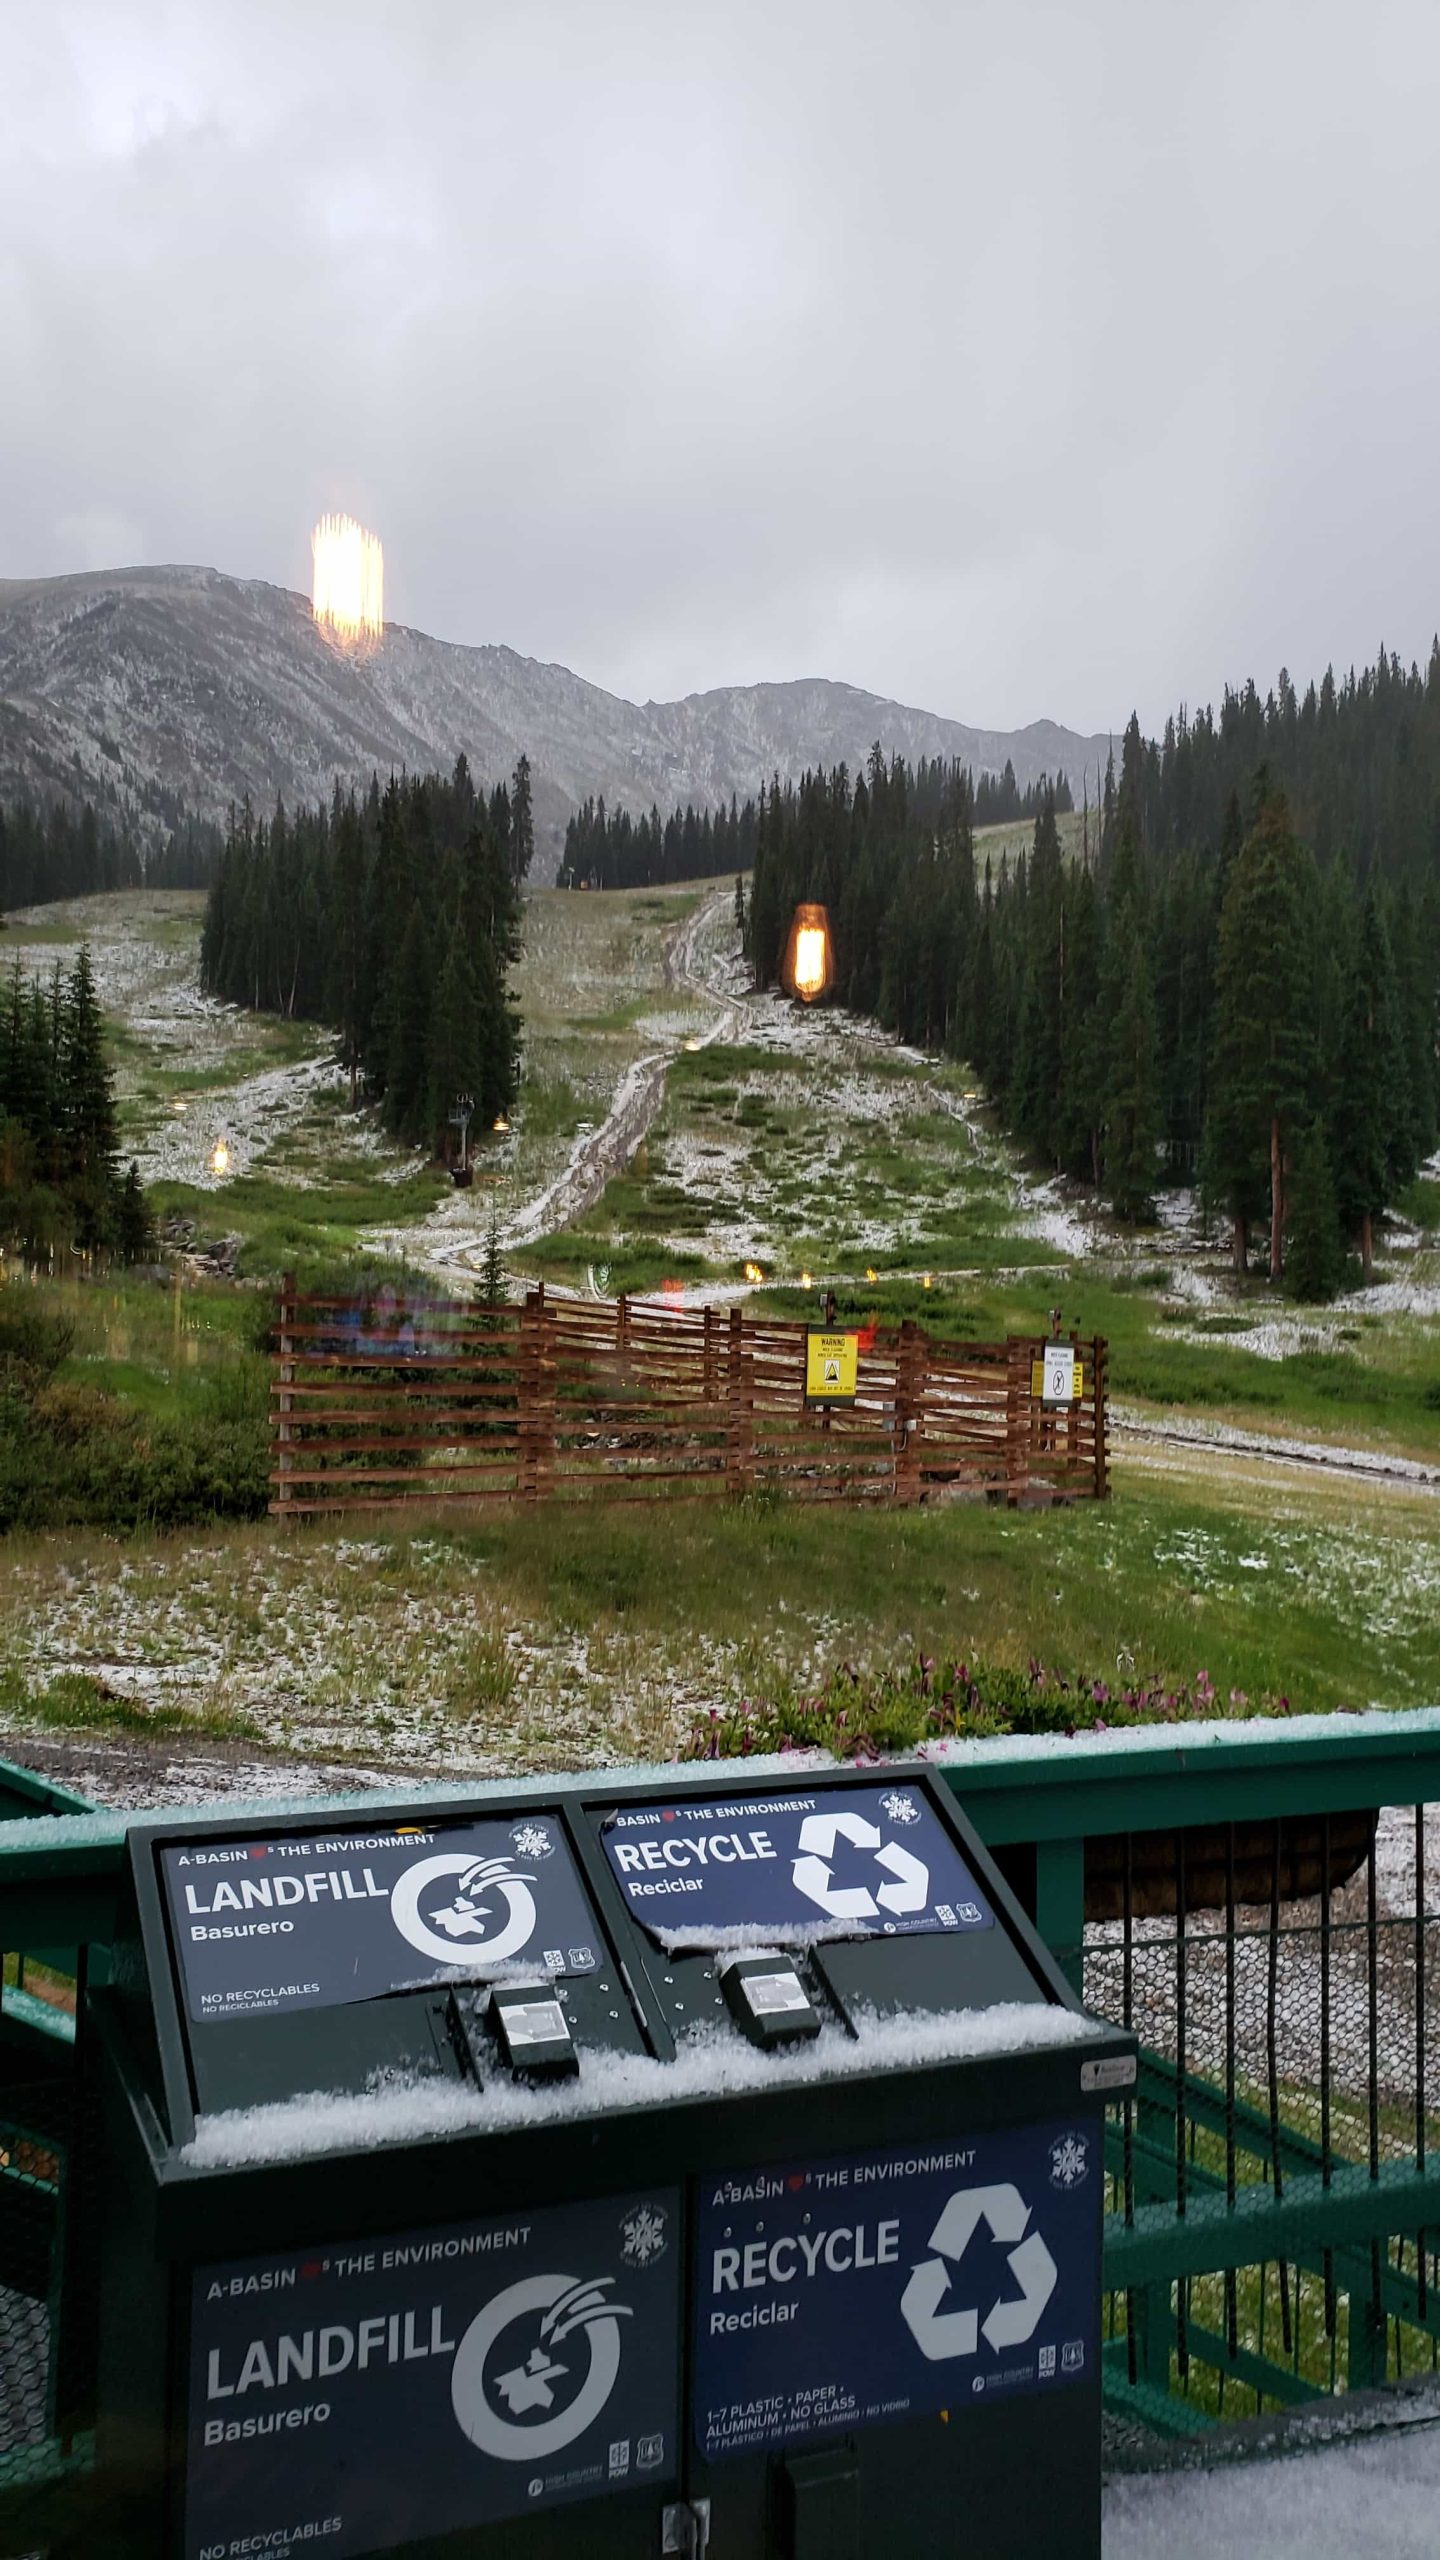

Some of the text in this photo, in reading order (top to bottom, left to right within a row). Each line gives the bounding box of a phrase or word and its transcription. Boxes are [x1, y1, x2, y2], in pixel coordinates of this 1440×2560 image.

[821, 1338, 845, 1346] WARNING
[616, 1813, 661, 1827] BASIN
[684, 1808, 713, 1820] THE
[715, 1799, 816, 1818] ENVIRONMENT
[178, 1850, 248, 1866] A-BASIN
[278, 1843, 310, 1857] THE
[315, 1834, 435, 1853] ENVIRONMENT
[614, 1831, 777, 1872] RECYCLE
[185, 1868, 389, 1914] LANDFILL
[627, 1876, 704, 1897] Reciclar
[190, 1918, 295, 1942] Basurero
[201, 1983, 320, 2005] NO RECYCLABLES
[202, 2005, 217, 2013] NO
[815, 2170, 848, 2190] THE
[854, 2150, 977, 2184] ENVIRONMENT
[206, 2268, 296, 2300] A-BASIN
[335, 2253, 376, 2277] THE
[382, 2227, 531, 2269] ENVIRONMENT
[712, 2219, 899, 2294] RECYCLE
[709, 2302, 799, 2335] Reciclar
[207, 2305, 456, 2400] LANDFILL
[706, 2395, 856, 2439] ALUMINUM NO GLASS
[730, 2395, 784, 2418] PLASTIC
[796, 2384, 836, 2406] PAPER
[204, 2403, 331, 2446] Basurero
[200, 2515, 342, 2560] NO RECYCLABLES
